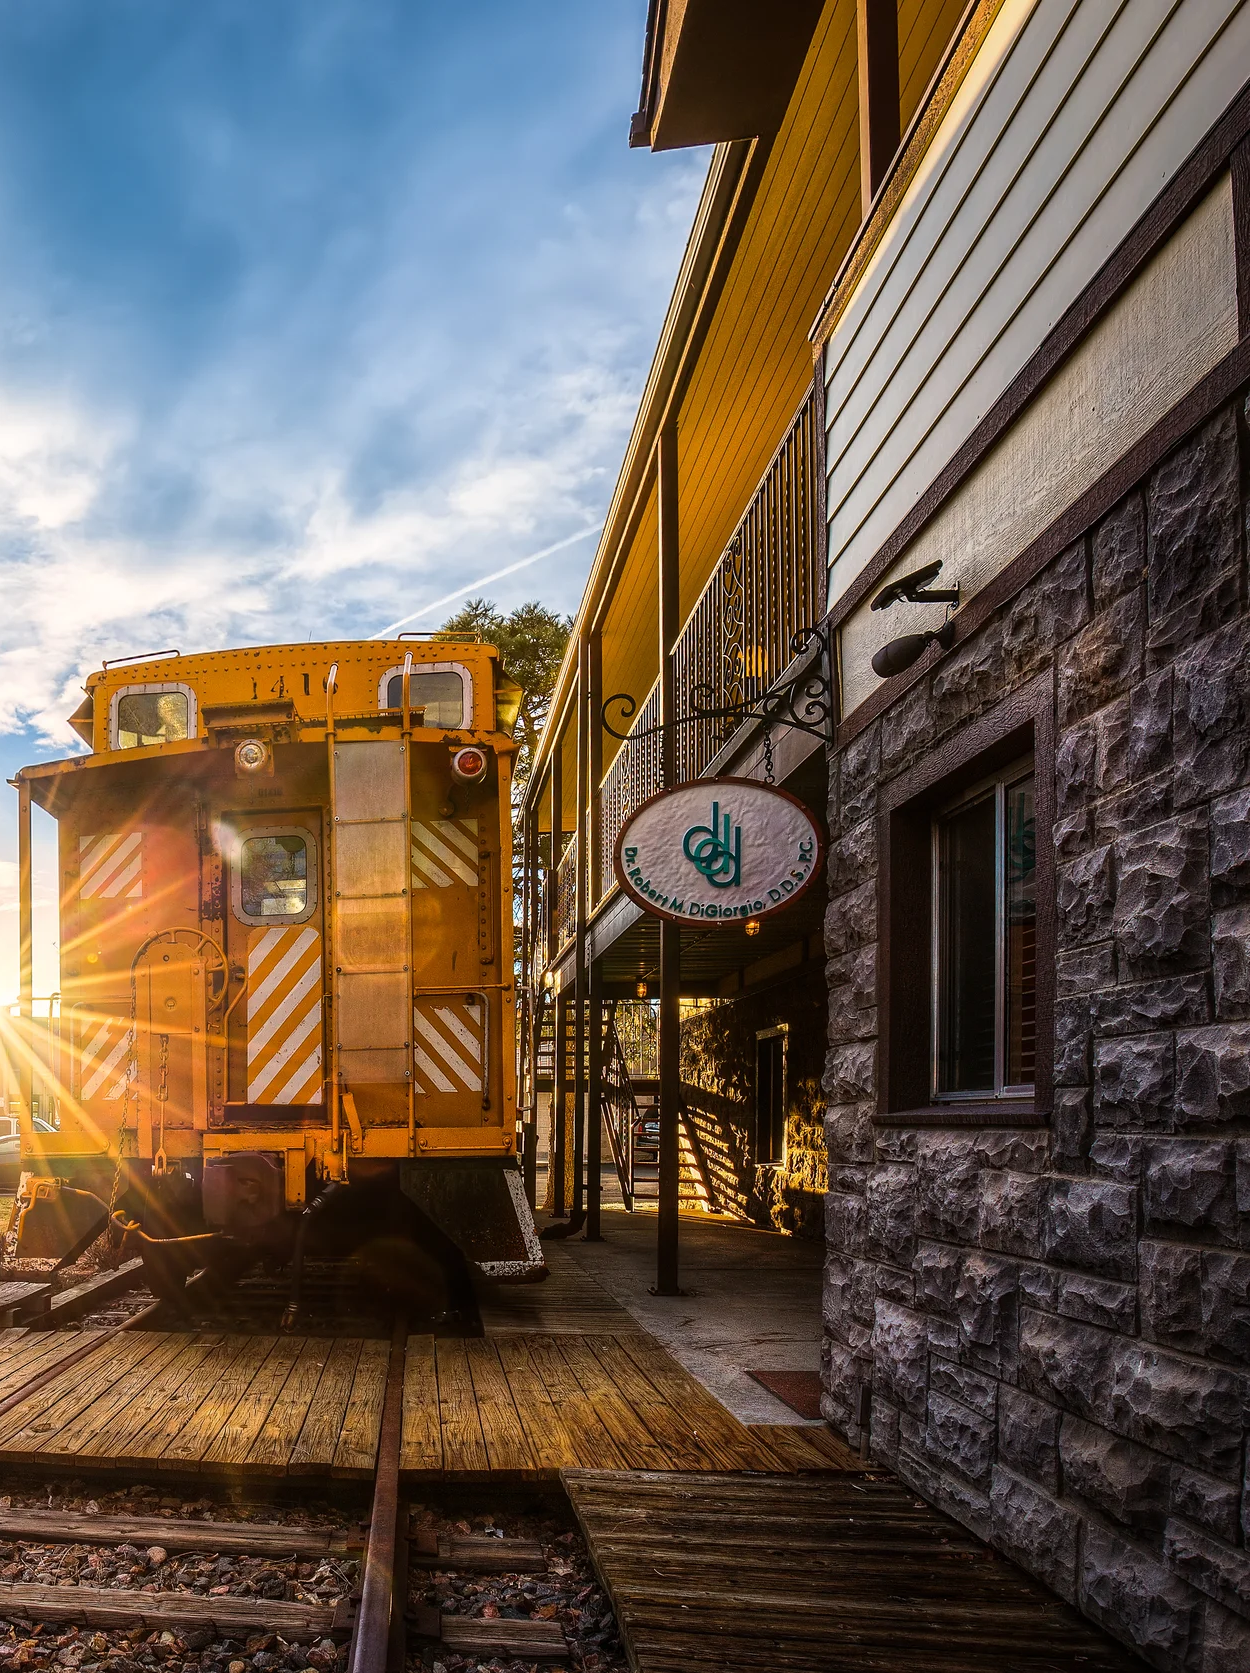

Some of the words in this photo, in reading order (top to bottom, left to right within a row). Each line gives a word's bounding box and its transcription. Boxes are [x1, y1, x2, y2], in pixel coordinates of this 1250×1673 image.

[624, 846, 638, 868] Dr.
[797, 836, 813, 862] P.C.
[627, 866, 669, 907] Robert
[668, 897, 686, 914] M.
[688, 899, 766, 917] DiGiorgio,
